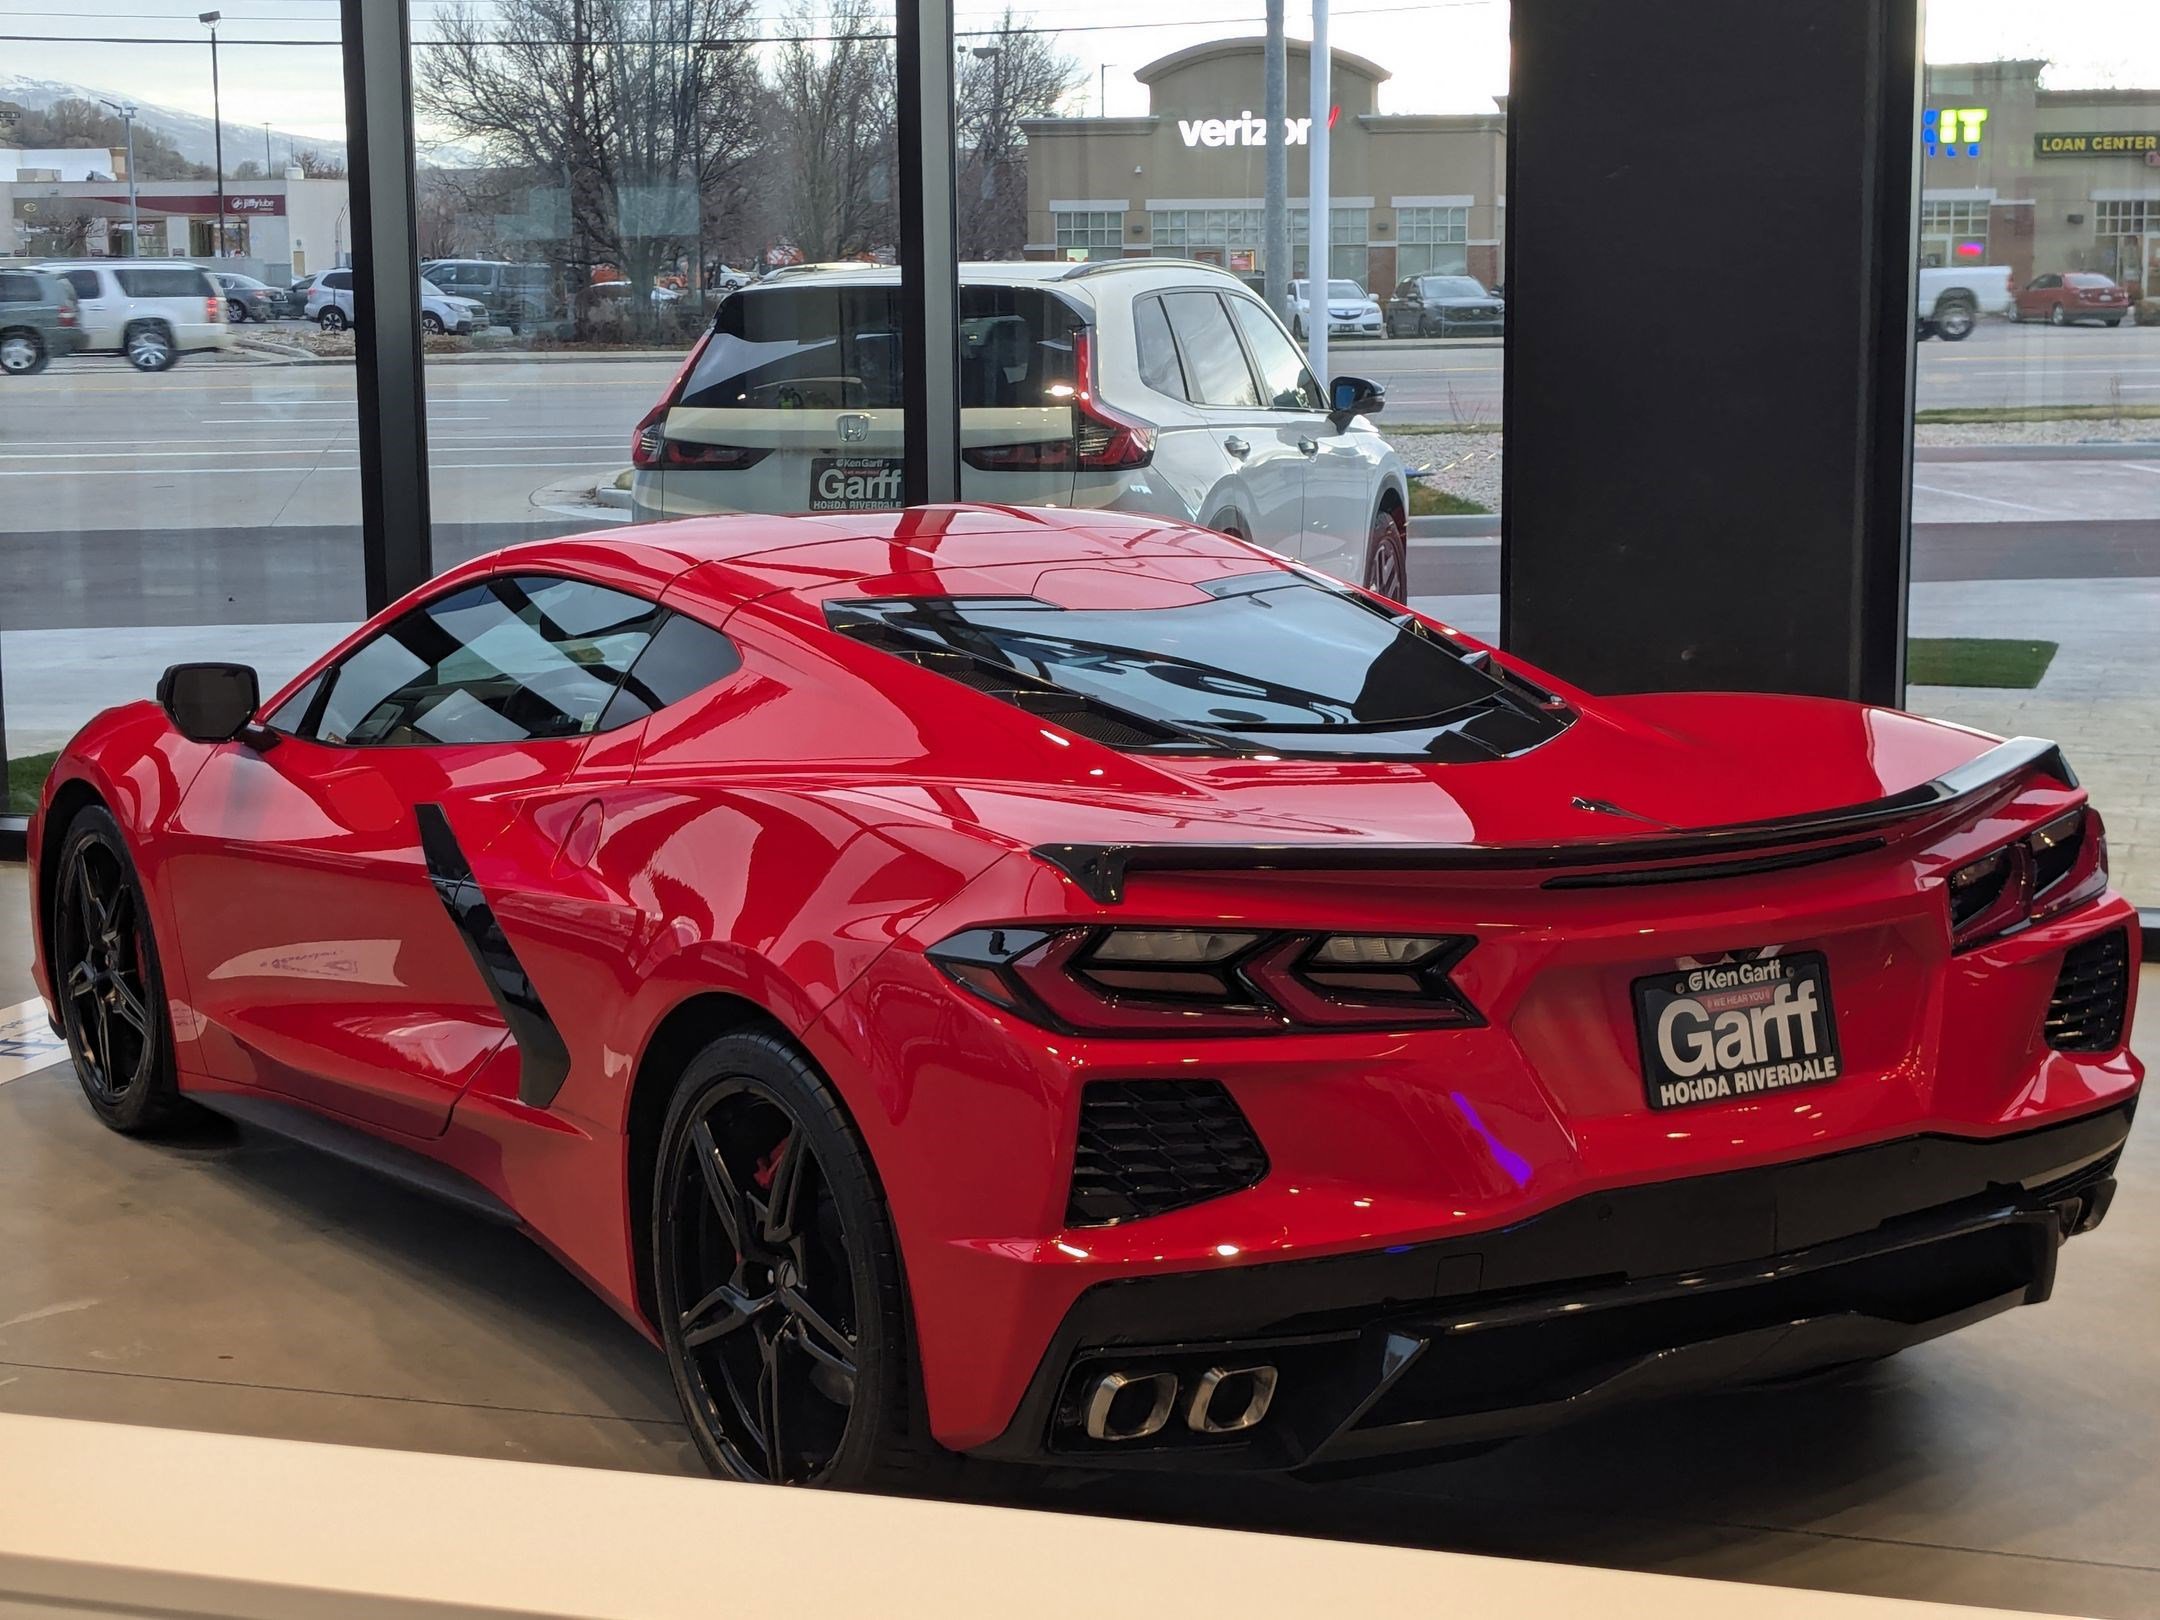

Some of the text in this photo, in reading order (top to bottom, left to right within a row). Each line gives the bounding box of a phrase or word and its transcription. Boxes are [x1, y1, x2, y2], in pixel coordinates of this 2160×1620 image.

[2042, 136, 2157, 151] LOAN CENTER
[844, 459, 884, 467] Ken Garff
[818, 468, 902, 499] Garff
[813, 500, 902, 510] HONDA RIVERDALE
[1705, 960, 1781, 989] Ken Garff
[1713, 992, 1766, 1008] WE HEAR YOU
[1657, 980, 1818, 1077] Garff
[1660, 1056, 1838, 1106] HONDA RIVERDALE
